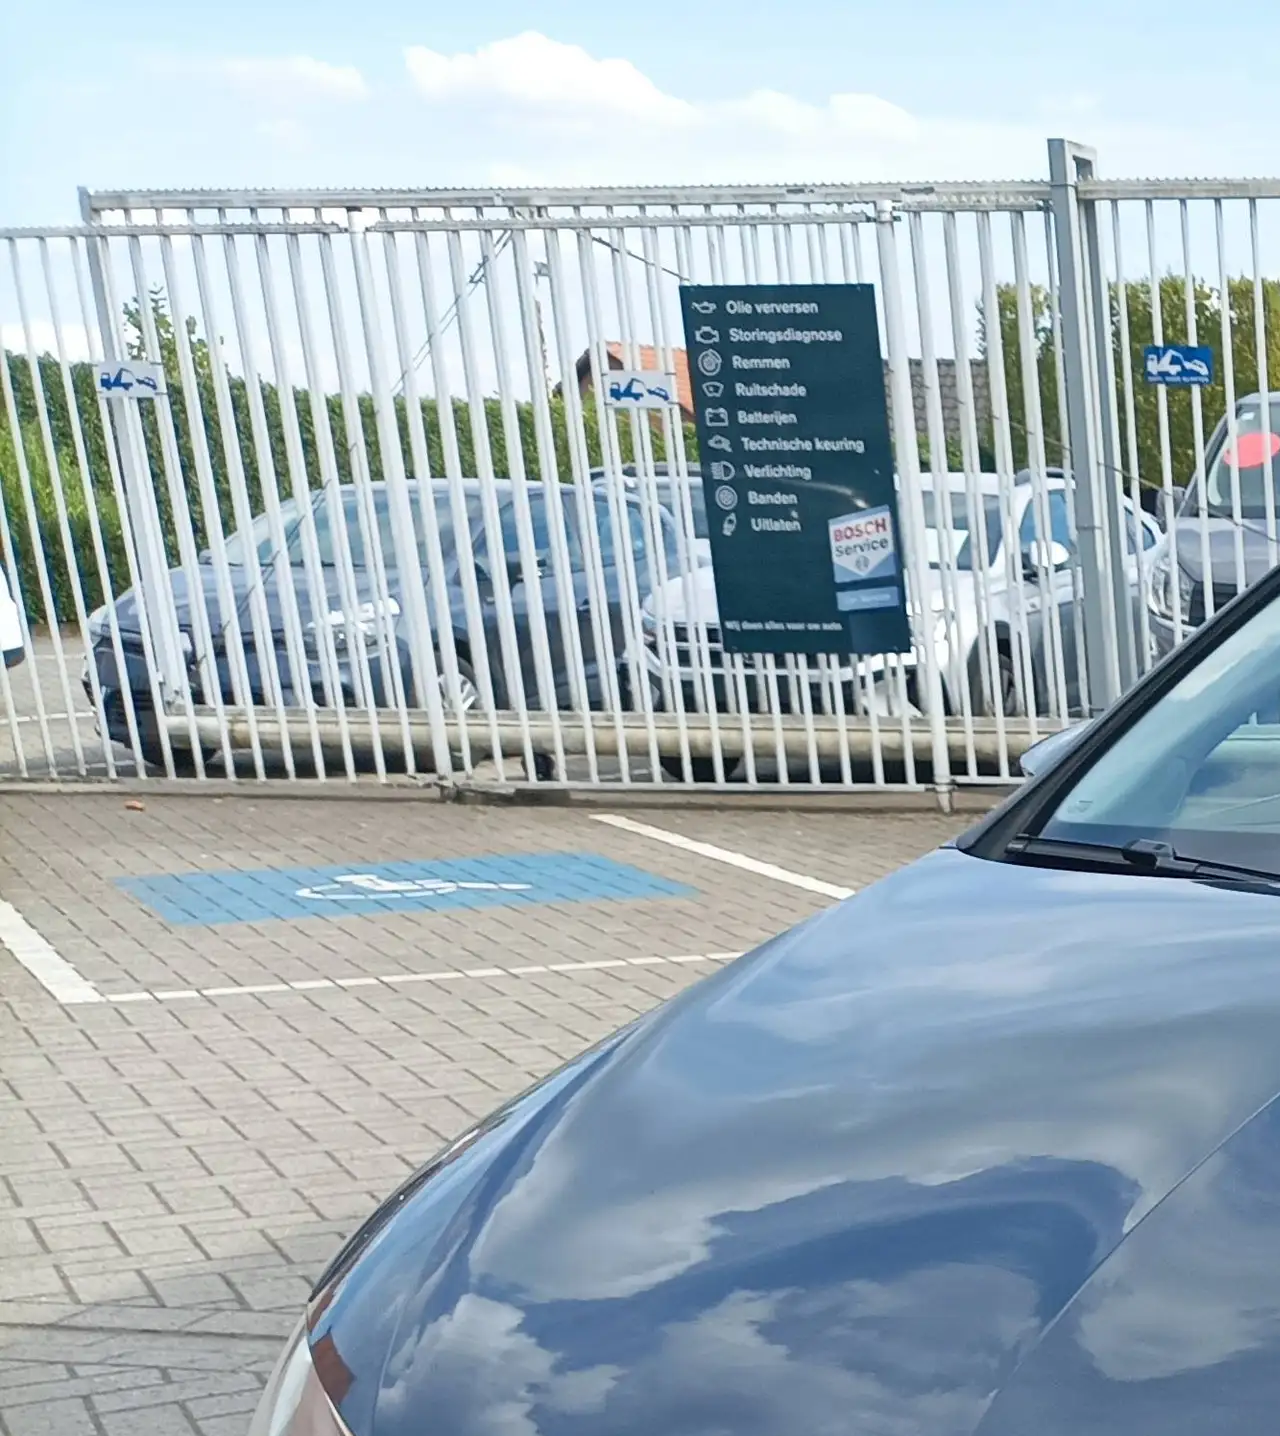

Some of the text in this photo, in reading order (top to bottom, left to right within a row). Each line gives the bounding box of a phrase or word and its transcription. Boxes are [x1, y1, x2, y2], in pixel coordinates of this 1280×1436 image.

[725, 299, 819, 315] Olie verversen
[729, 327, 843, 345] Storingsdiagnose
[732, 354, 791, 370] Remmen
[735, 382, 807, 397] Ruitschade
[737, 410, 798, 426] Batterijen
[740, 436, 865, 454] Technische keuring
[743, 464, 812, 481] Verlichting
[747, 490, 798, 505] Banden
[750, 516, 802, 532] Uitlaten
[833, 518, 888, 542] BOSCH
[835, 537, 889, 557] Service
